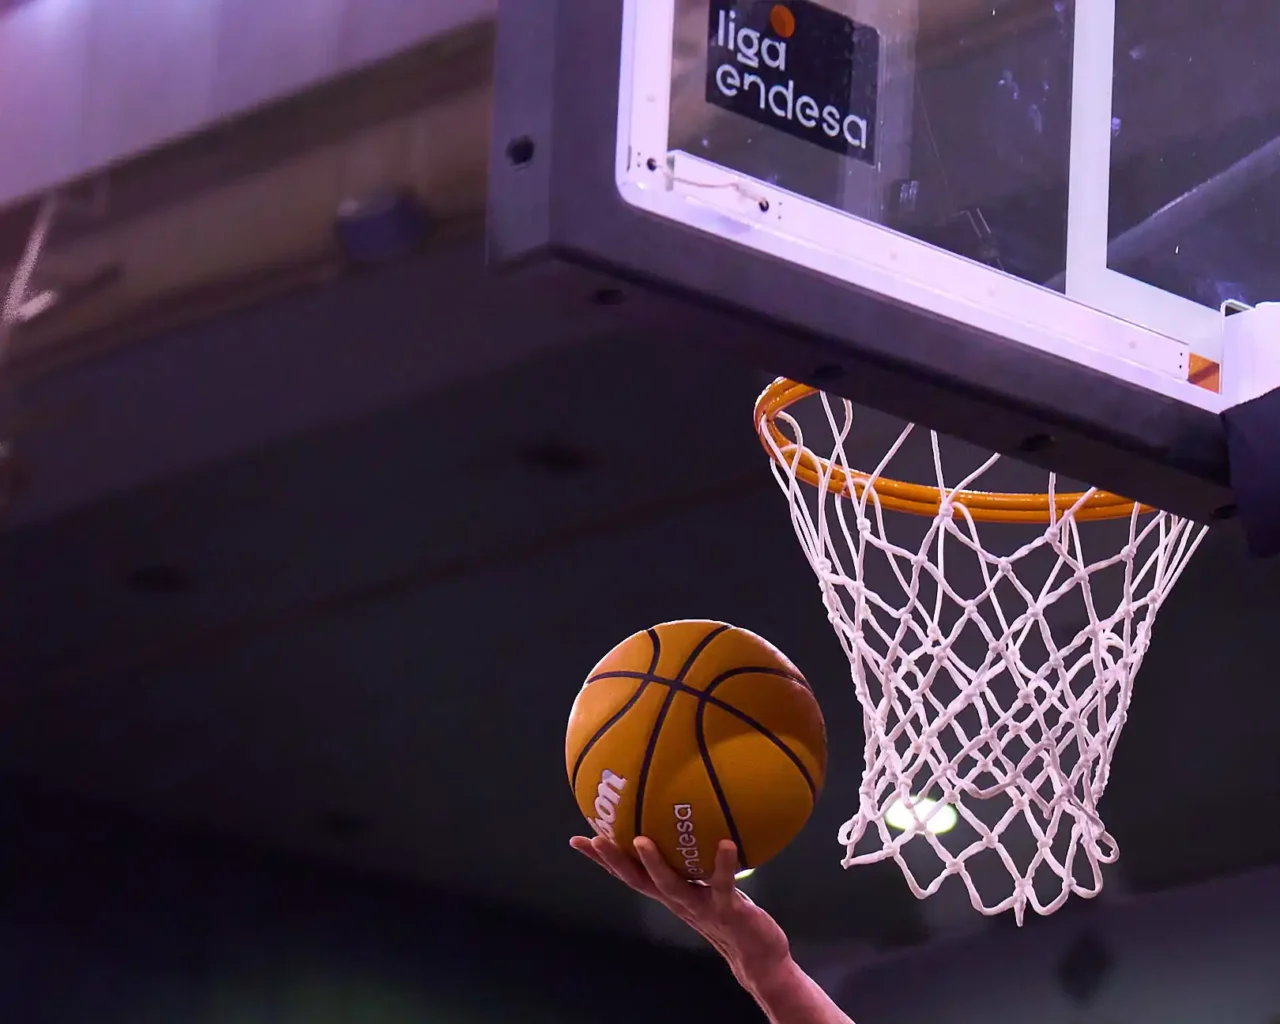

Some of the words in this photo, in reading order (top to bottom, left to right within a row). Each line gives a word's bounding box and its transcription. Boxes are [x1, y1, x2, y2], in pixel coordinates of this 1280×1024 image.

[717, 9, 787, 71] liga
[715, 63, 867, 149] endesa
[674, 803, 704, 876] endesa
